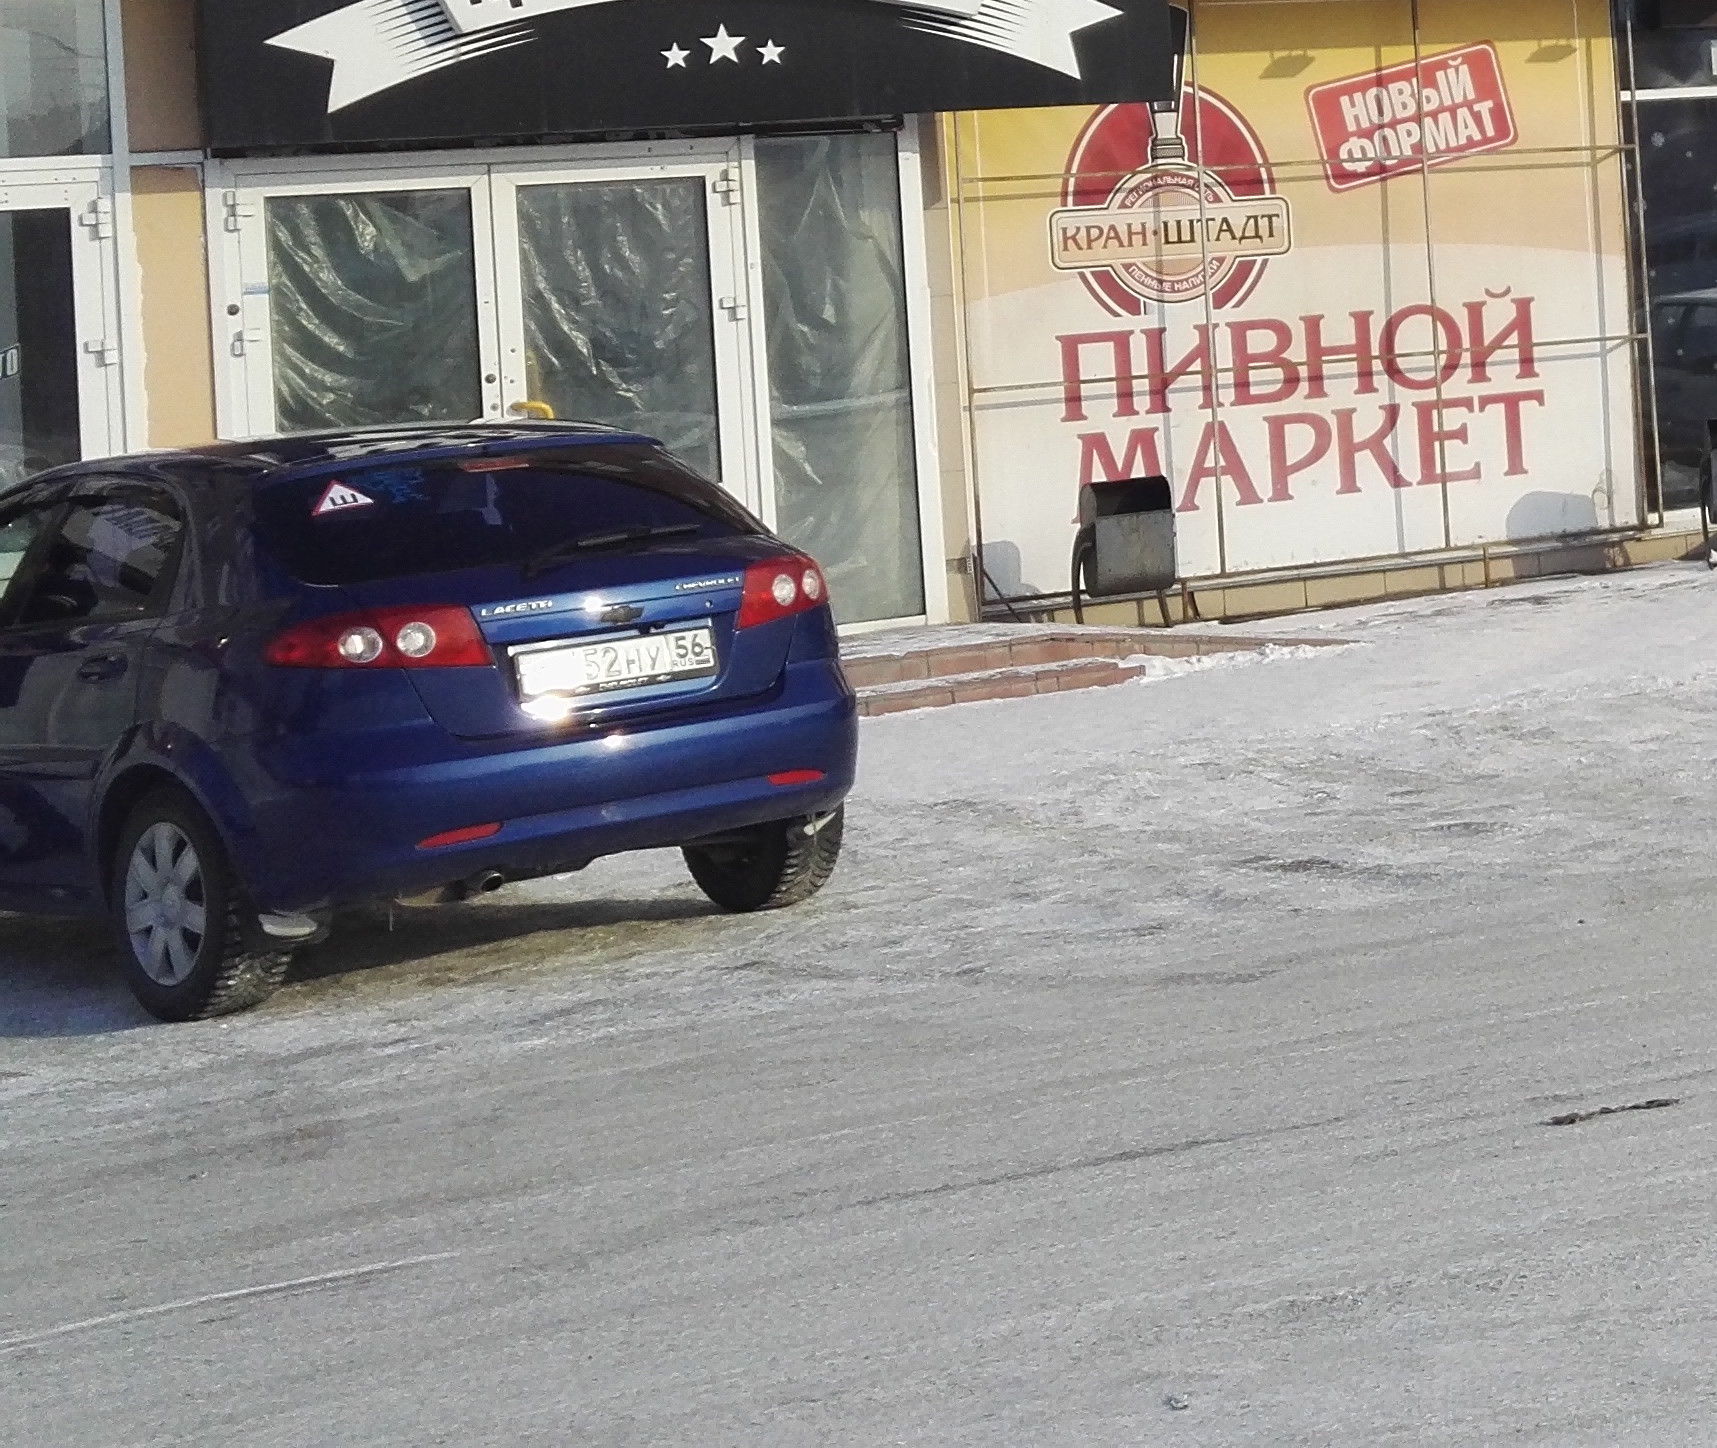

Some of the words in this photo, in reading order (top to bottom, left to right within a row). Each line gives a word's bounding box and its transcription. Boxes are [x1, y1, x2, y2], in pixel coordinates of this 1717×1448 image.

[1339, 56, 1476, 133] НОВЫЙ
[1339, 99, 1495, 173] ФОРМАТ
[1054, 286, 1540, 423] ПИВНОЙ
[329, 492, 359, 507] Ш
[672, 657, 695, 668] RUS
[674, 632, 705, 659] 56
